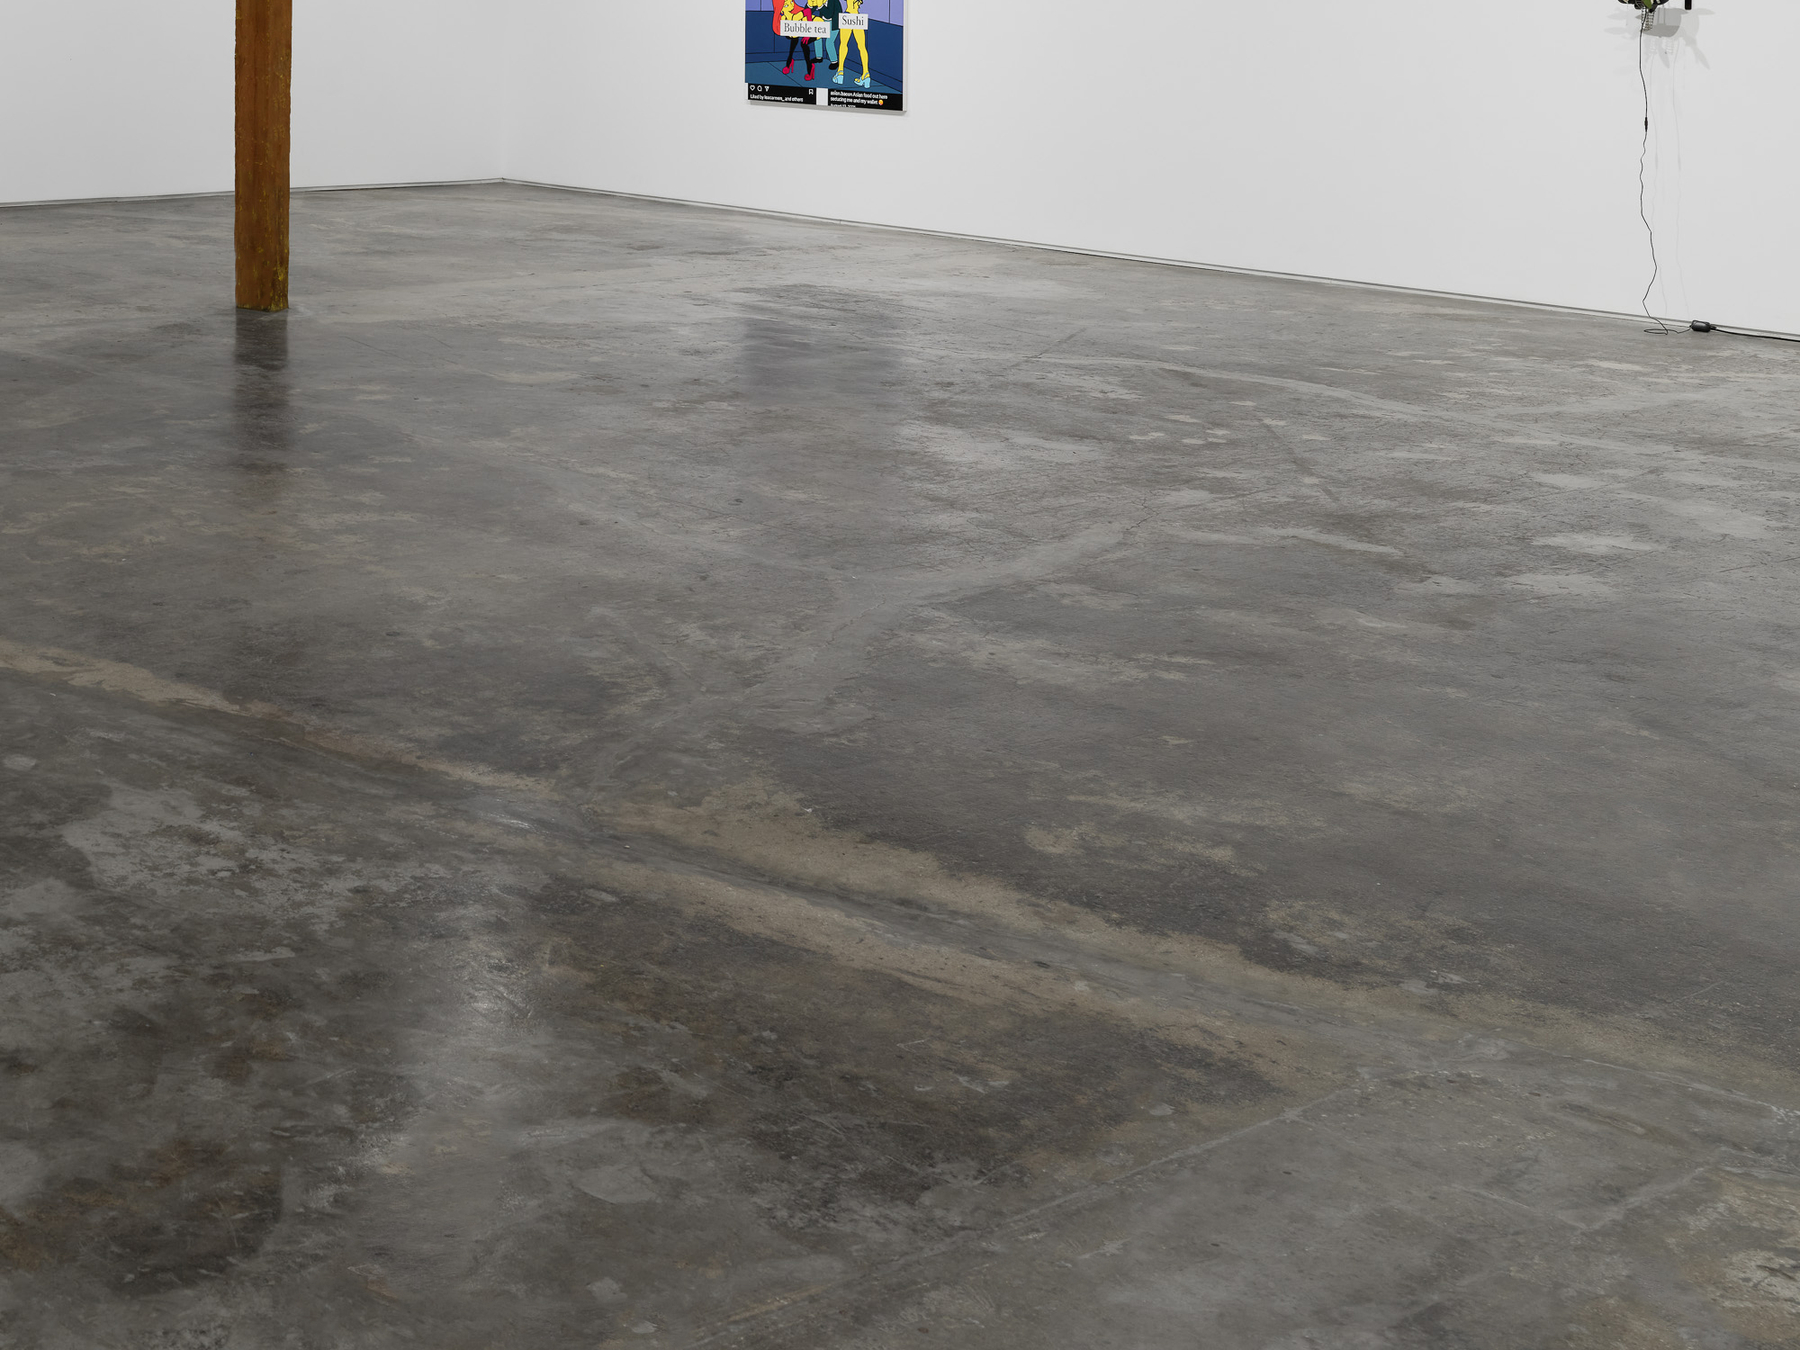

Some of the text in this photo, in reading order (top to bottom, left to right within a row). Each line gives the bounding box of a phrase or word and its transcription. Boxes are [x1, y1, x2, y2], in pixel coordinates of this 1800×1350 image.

[842, 15, 864, 26] Sushi
[784, 23, 827, 34] Bubble tea
